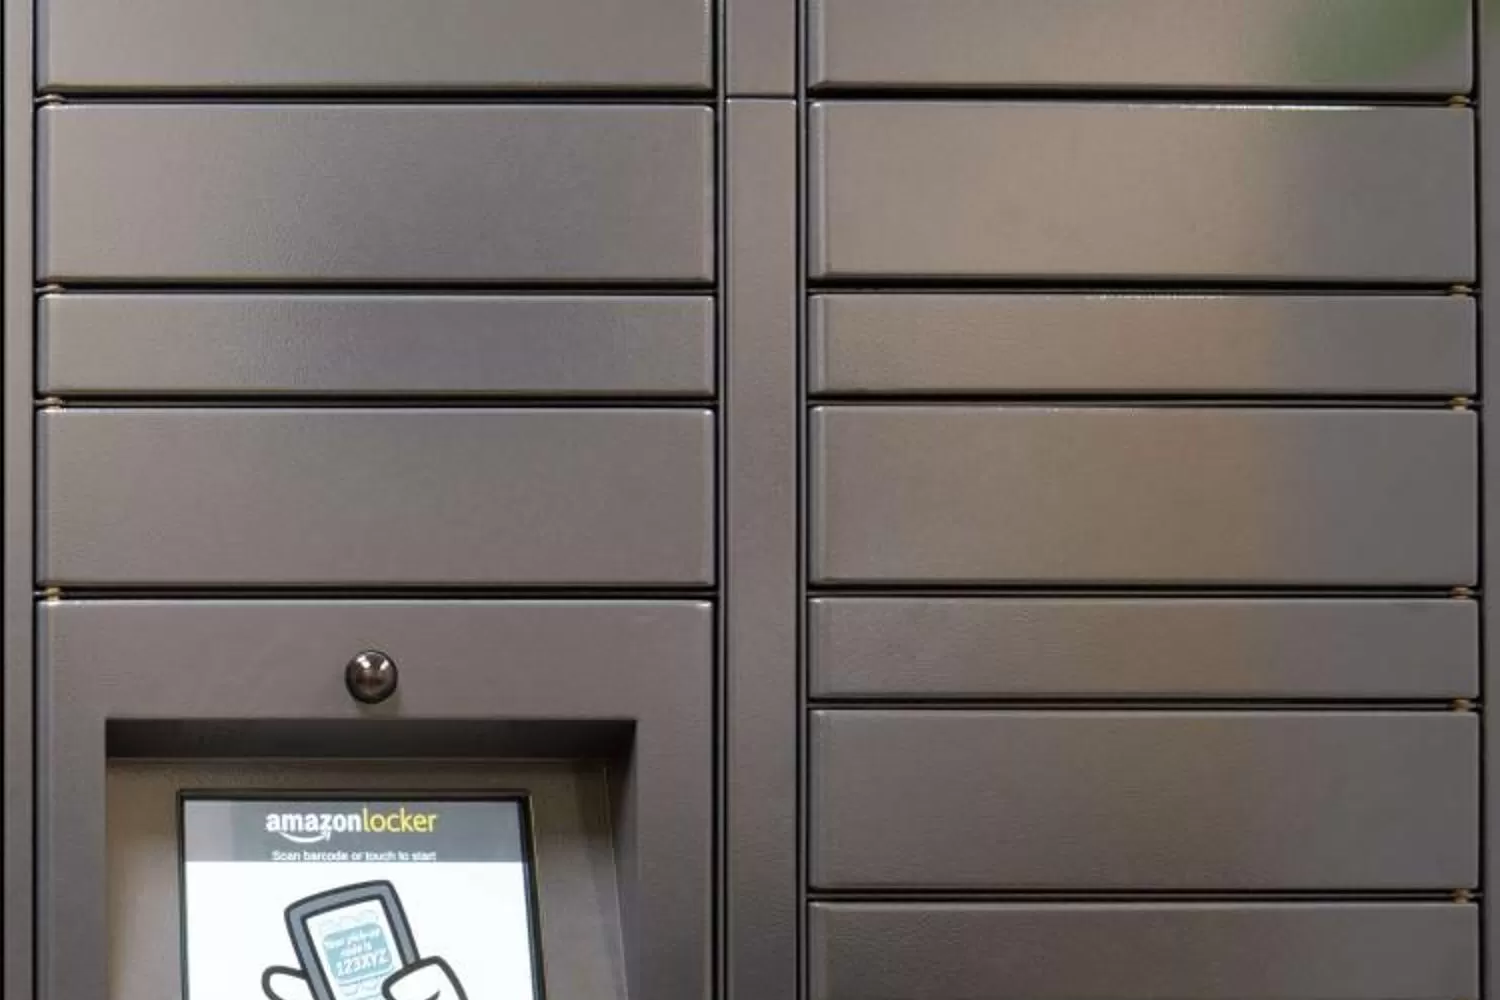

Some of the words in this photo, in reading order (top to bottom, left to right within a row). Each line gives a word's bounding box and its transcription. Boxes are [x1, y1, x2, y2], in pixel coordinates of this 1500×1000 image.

[271, 850, 301, 862] Scan
[303, 850, 349, 862] barcode
[351, 852, 363, 862] or
[365, 850, 397, 862] touch
[398, 850, 409, 862] to
[412, 850, 437, 862] start
[335, 948, 388, 977] 123XYZ
